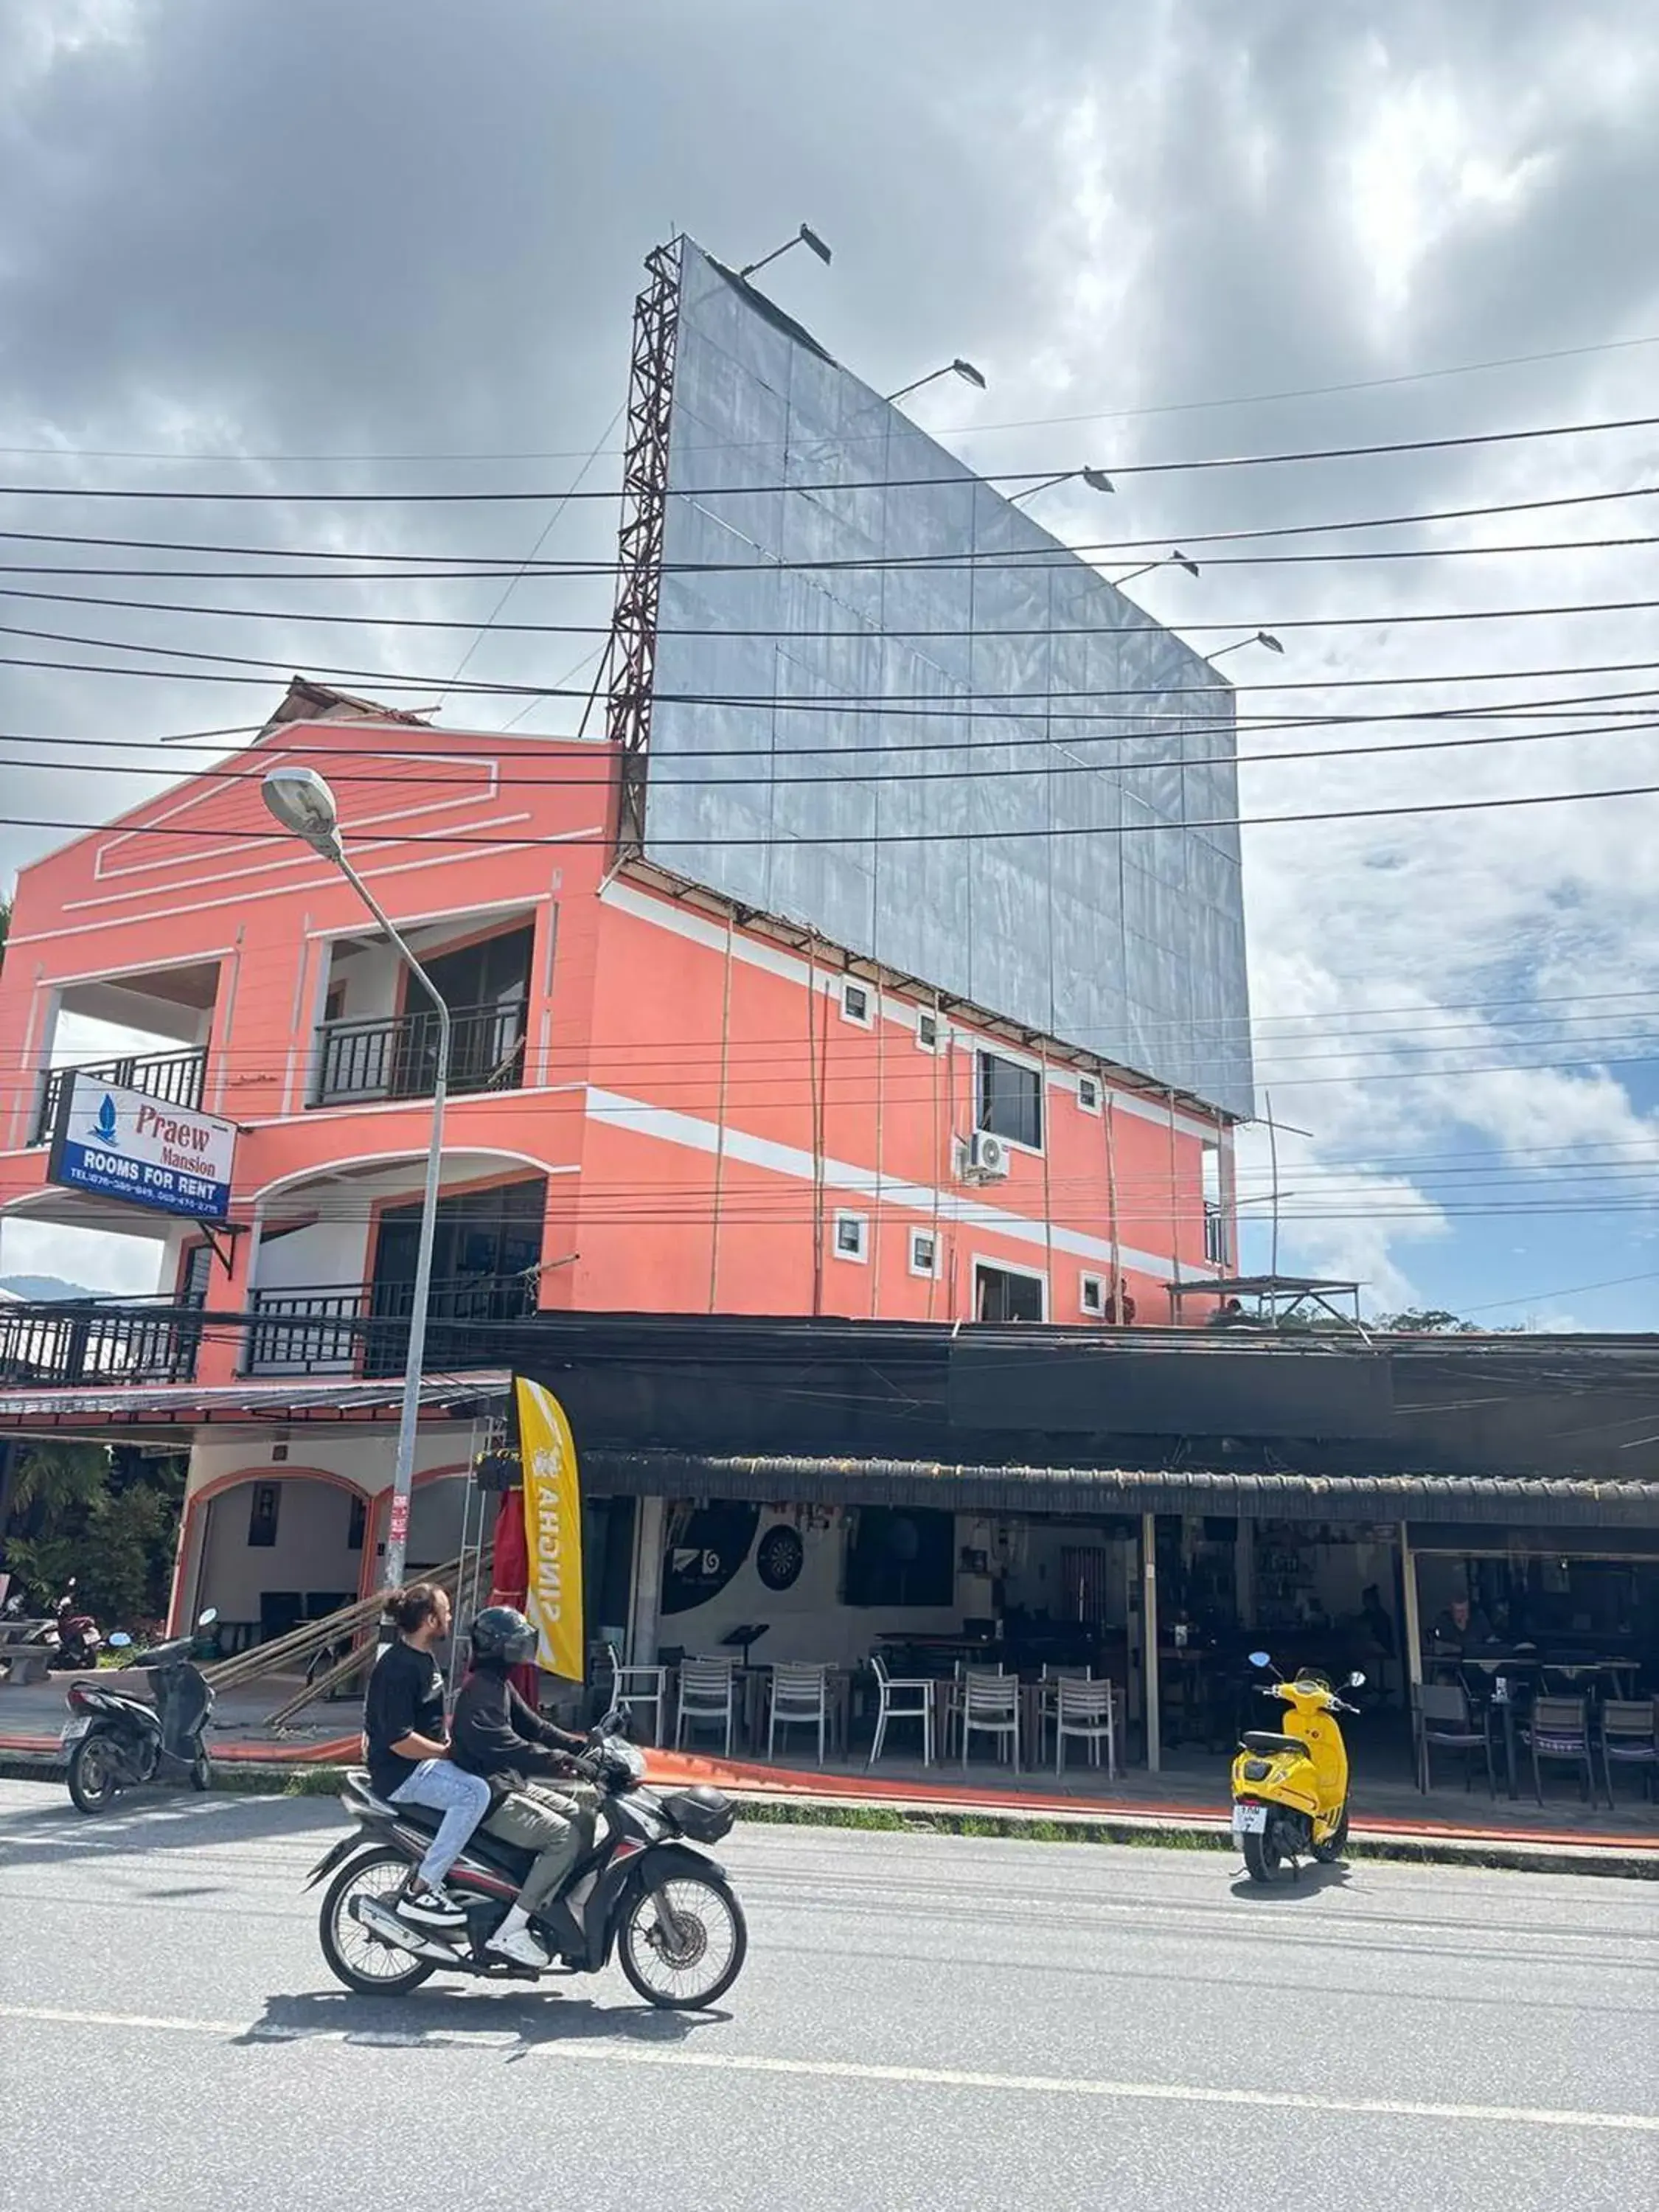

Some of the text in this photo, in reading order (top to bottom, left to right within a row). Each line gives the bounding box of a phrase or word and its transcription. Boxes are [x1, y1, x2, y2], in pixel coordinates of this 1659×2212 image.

[136, 1104, 210, 1152] Praew
[83, 1150, 216, 1200] ROOMS FOR RENT
[160, 1147, 216, 1178] Mansion
